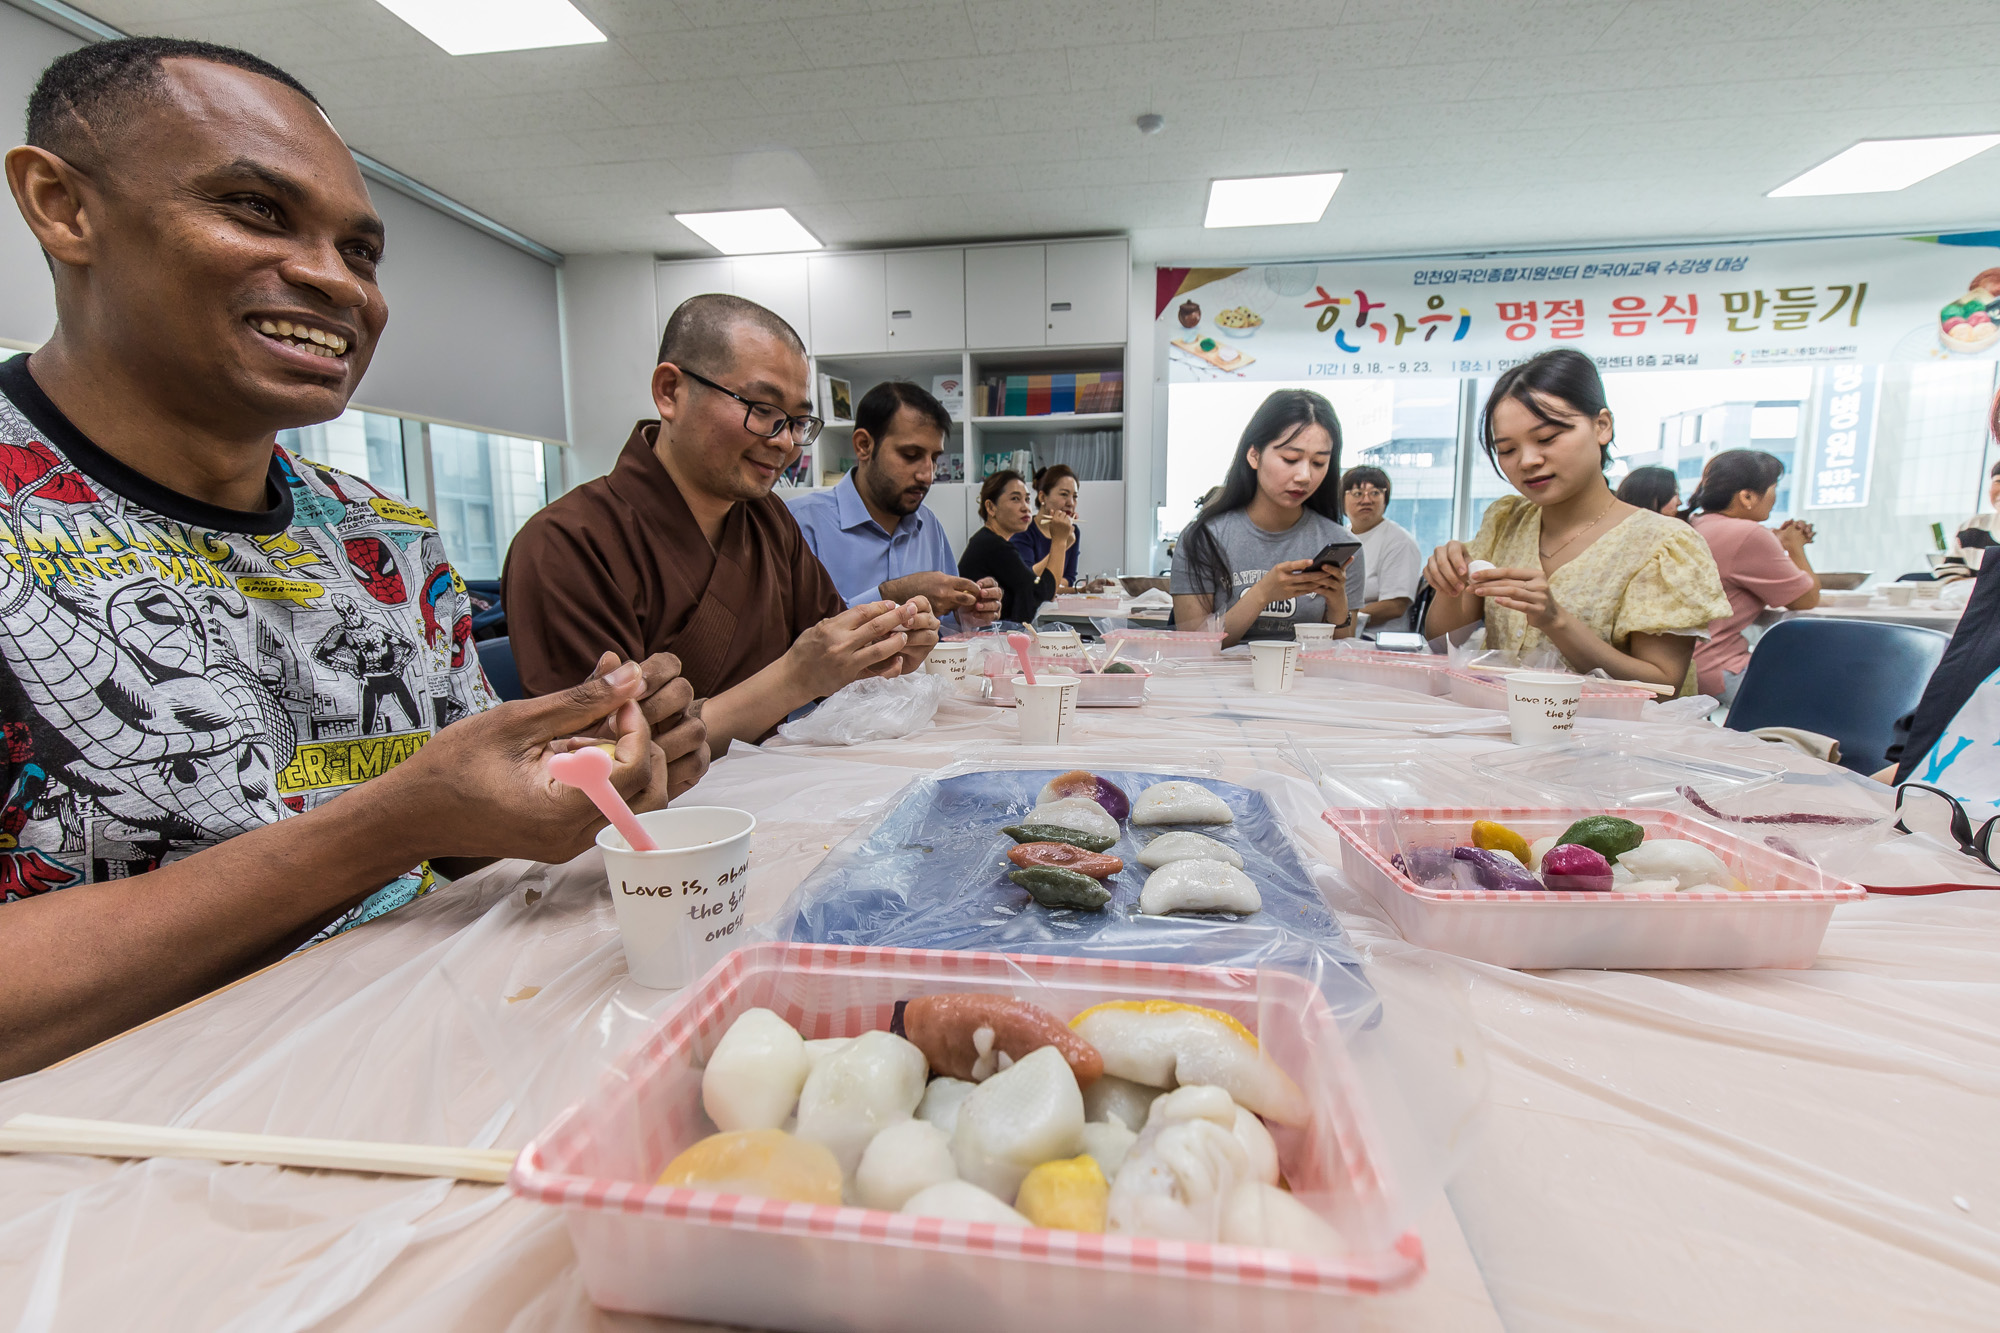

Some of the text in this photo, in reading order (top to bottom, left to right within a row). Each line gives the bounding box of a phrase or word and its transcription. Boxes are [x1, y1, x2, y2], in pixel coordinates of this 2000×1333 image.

[1413, 255, 1750, 286] 인천외국인종합지원센터 한국어교육 수강생 대상
[1304, 282, 1869, 353] 한가위 명절 음식 만들기
[1514, 694, 1540, 705] Love
[1544, 697, 1558, 707] is,
[1544, 709, 1564, 718] the
[621, 880, 673, 898] Love
[681, 879, 709, 896] is,
[686, 902, 724, 920] the
